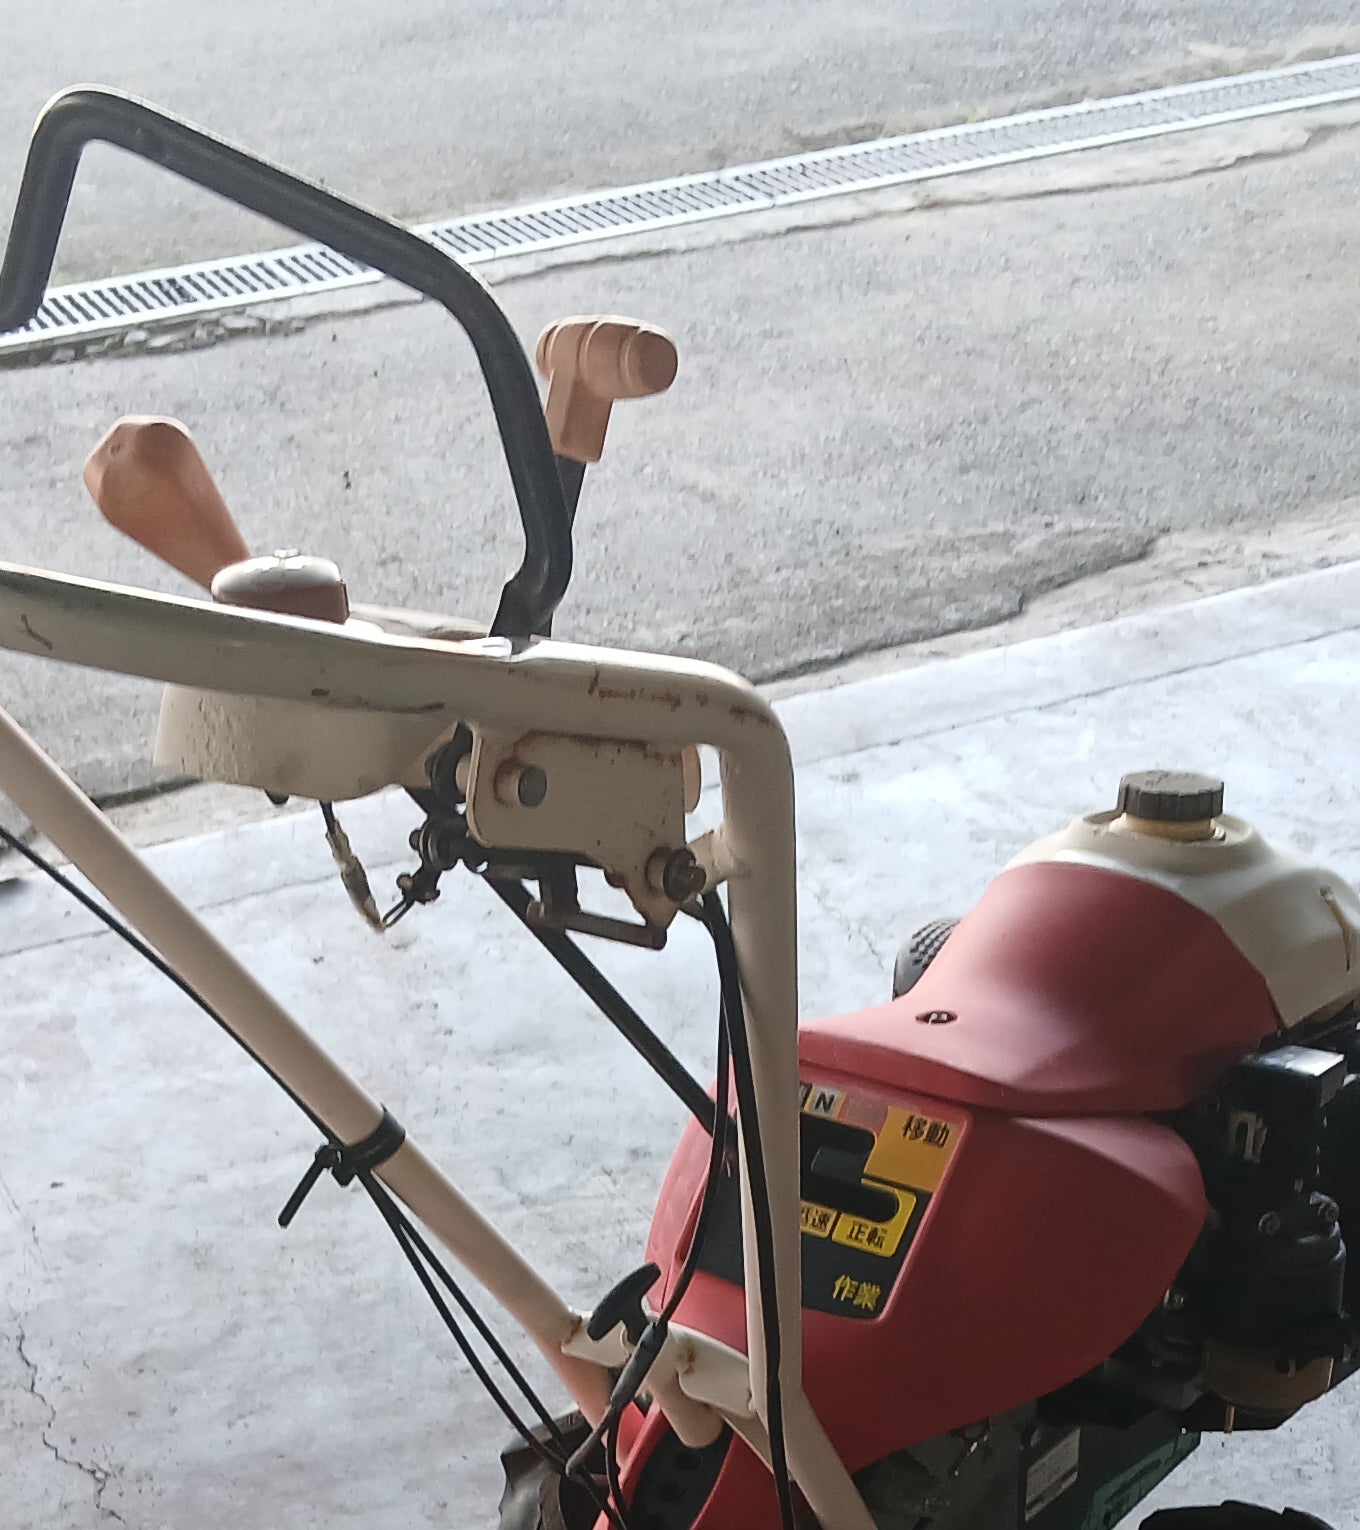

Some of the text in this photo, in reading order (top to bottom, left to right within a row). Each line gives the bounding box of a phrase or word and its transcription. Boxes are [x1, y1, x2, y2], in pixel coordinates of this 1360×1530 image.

[814, 1091, 835, 1113] N
[903, 1114, 950, 1148] 移動
[846, 1220, 888, 1249] 正転
[832, 1274, 881, 1312] 作業
